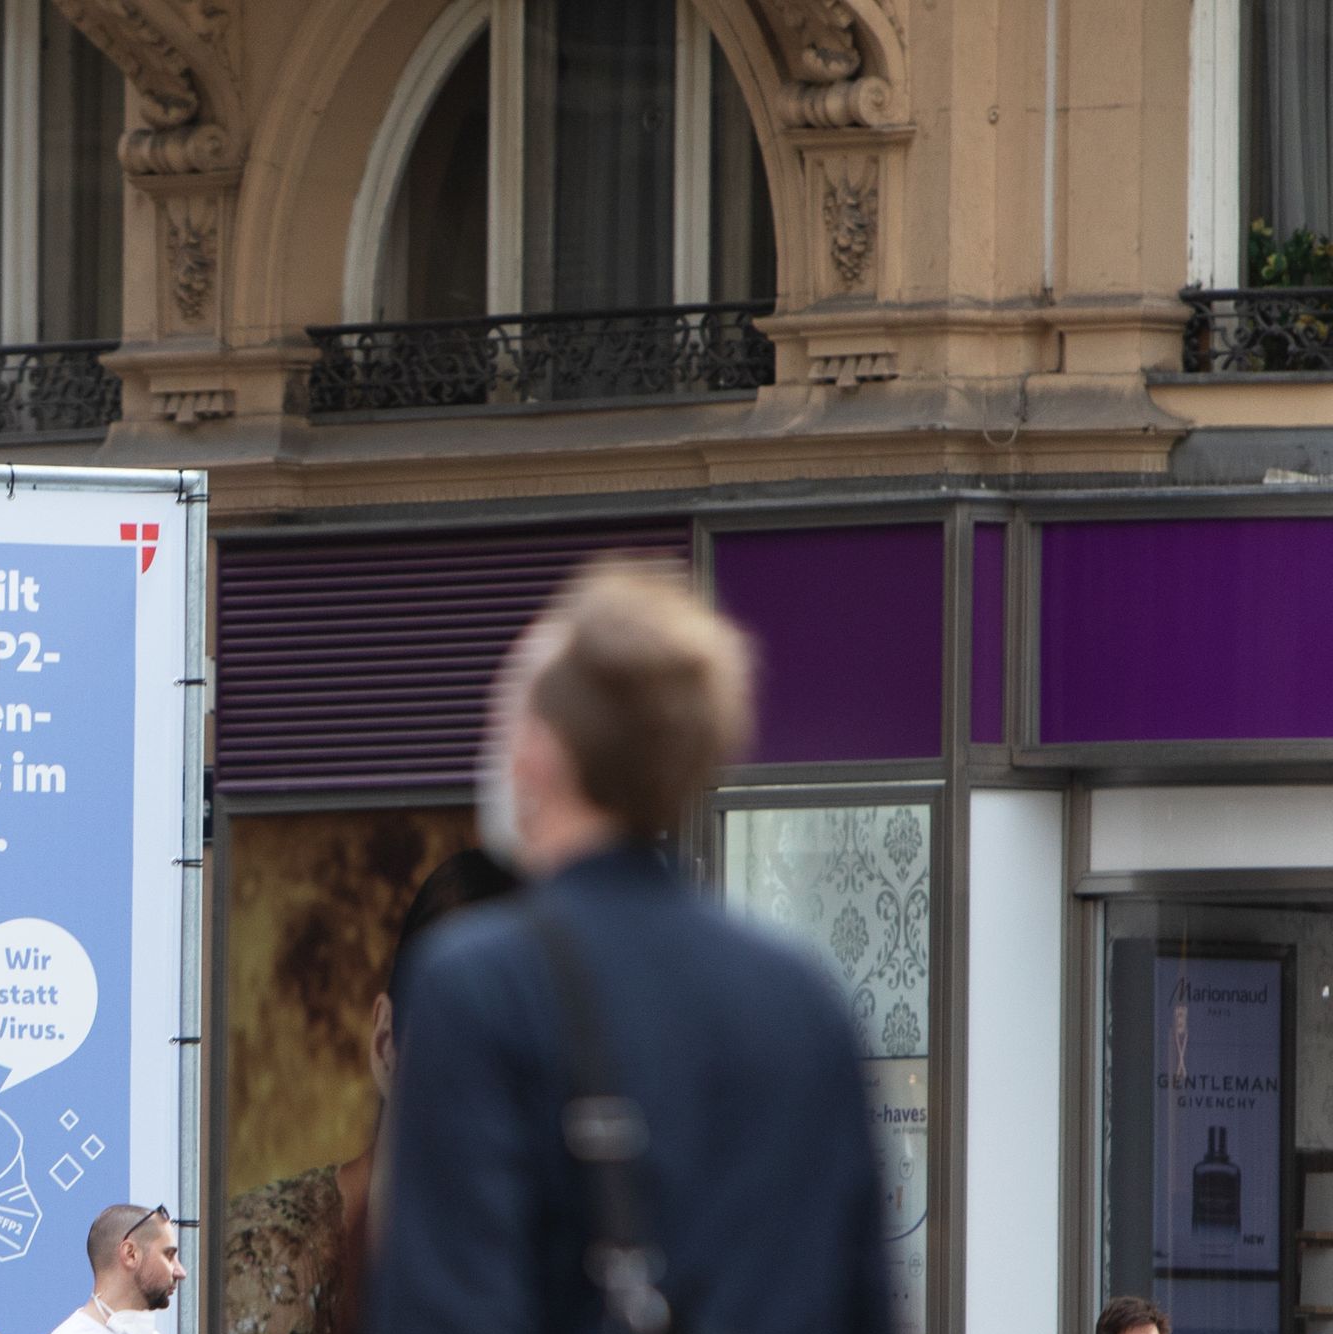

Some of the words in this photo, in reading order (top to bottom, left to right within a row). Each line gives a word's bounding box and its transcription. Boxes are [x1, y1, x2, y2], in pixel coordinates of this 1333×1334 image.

[13, 750, 66, 793] im
[5, 947, 51, 970] Wir
[1168, 977, 1268, 1006] Marionnaud
[1157, 1073, 1278, 1093] GENTLEMAN
[1177, 1095, 1257, 1109] GIVENCHY
